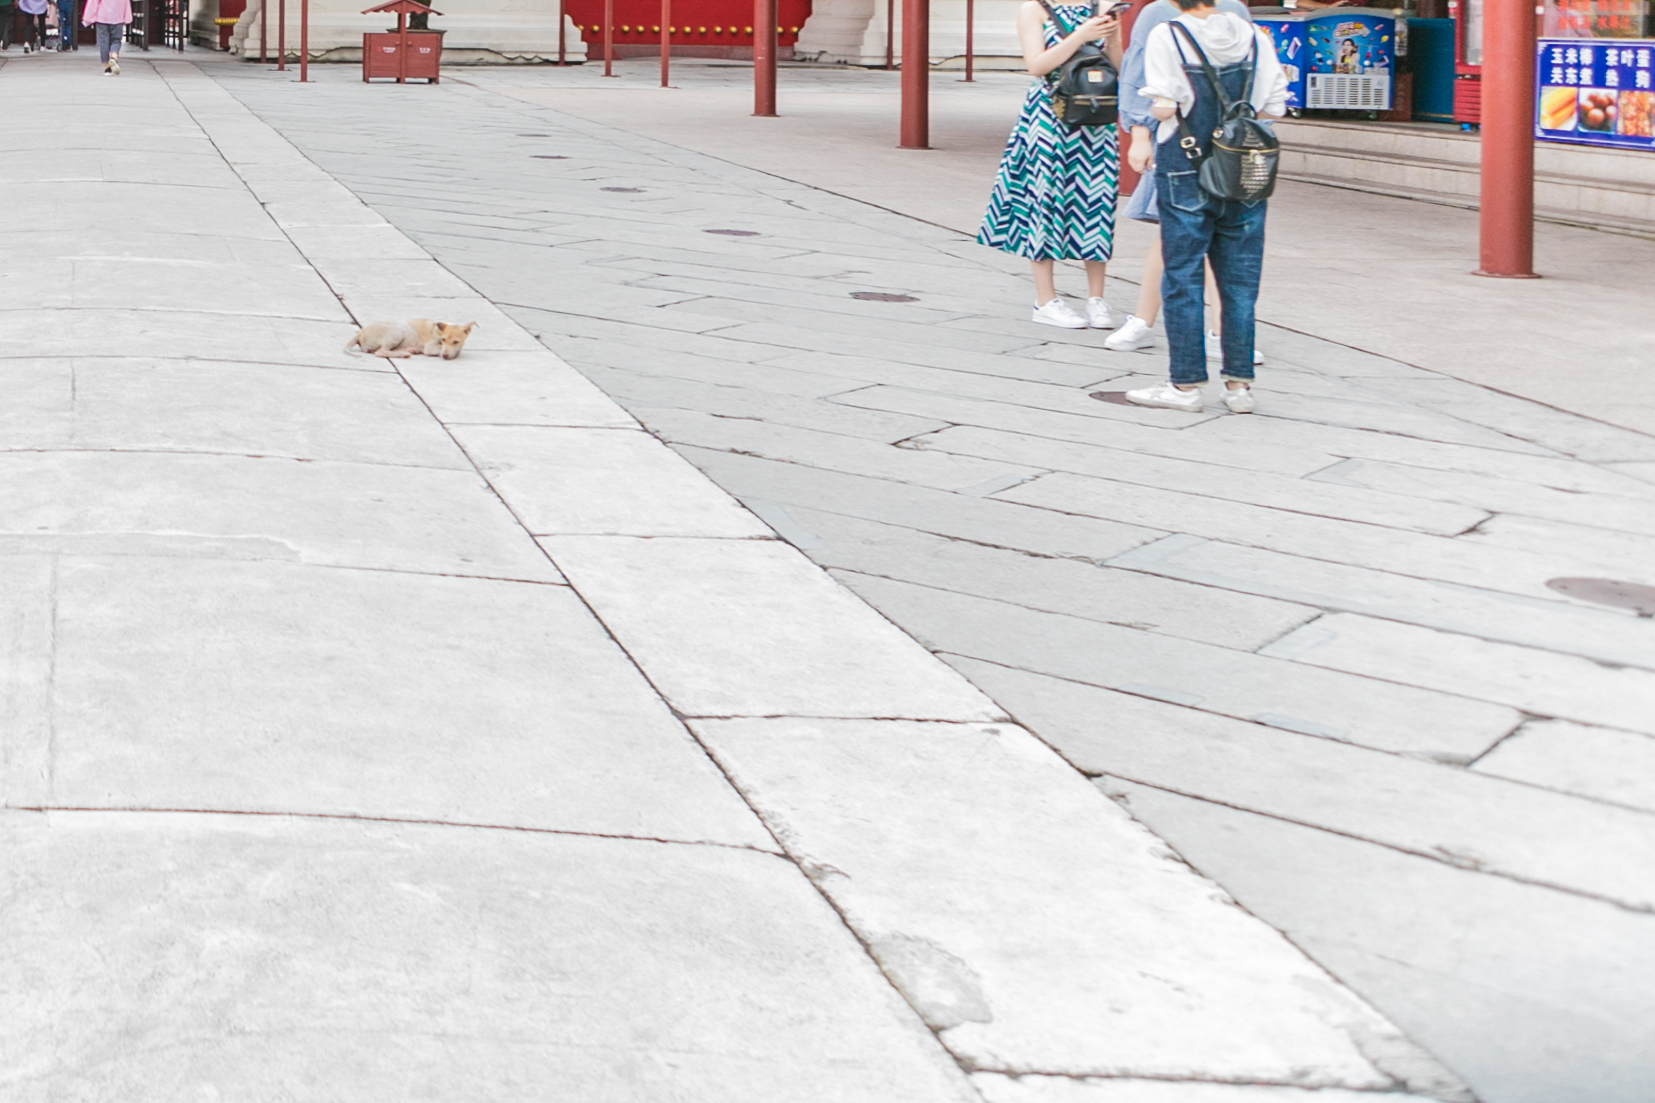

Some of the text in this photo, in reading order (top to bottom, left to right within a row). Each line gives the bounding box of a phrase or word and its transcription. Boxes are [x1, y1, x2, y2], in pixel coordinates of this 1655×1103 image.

[1606, 49, 1650, 67] 茶叶蛋
[1550, 67, 1593, 85] 关东煮
